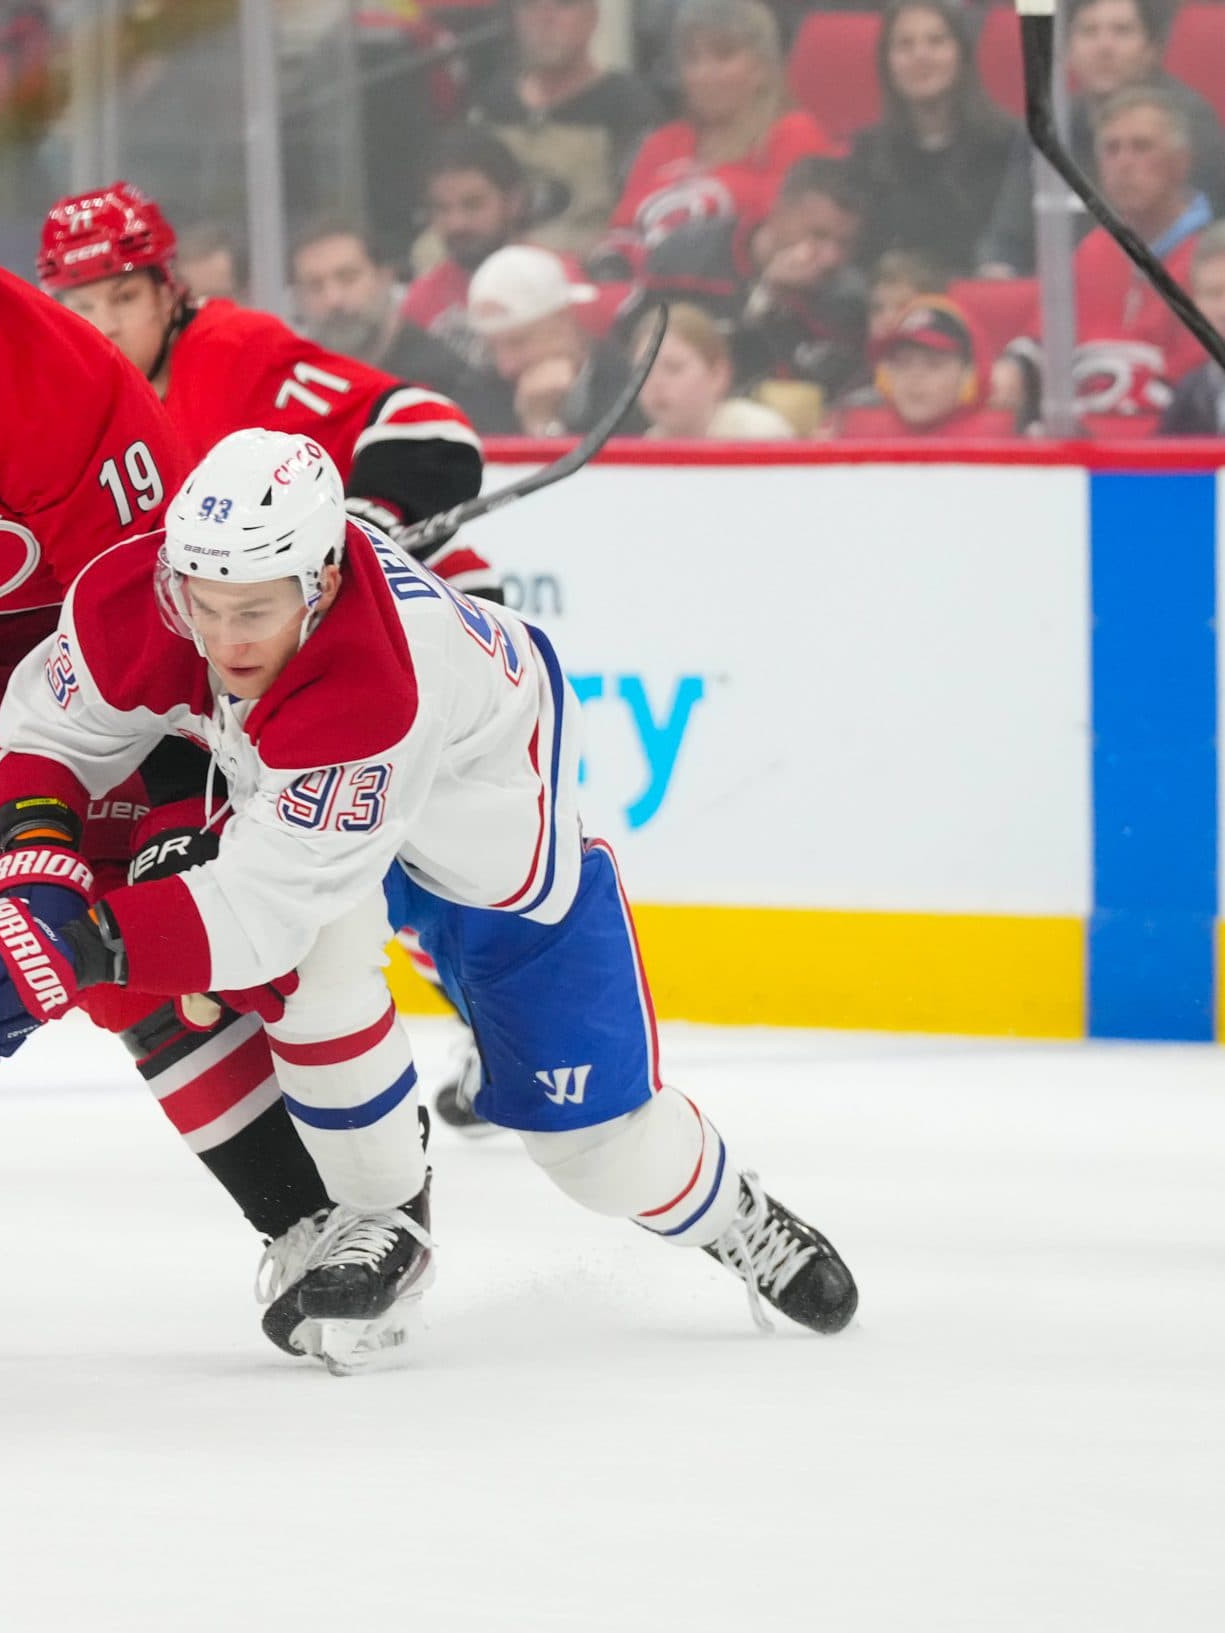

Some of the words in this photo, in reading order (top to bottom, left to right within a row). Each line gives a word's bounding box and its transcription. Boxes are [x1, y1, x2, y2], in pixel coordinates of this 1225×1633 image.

[275, 362, 350, 416] 71
[98, 439, 165, 527] 19
[198, 496, 233, 524] 93
[183, 544, 231, 557] BAUER
[277, 762, 393, 834] 93
